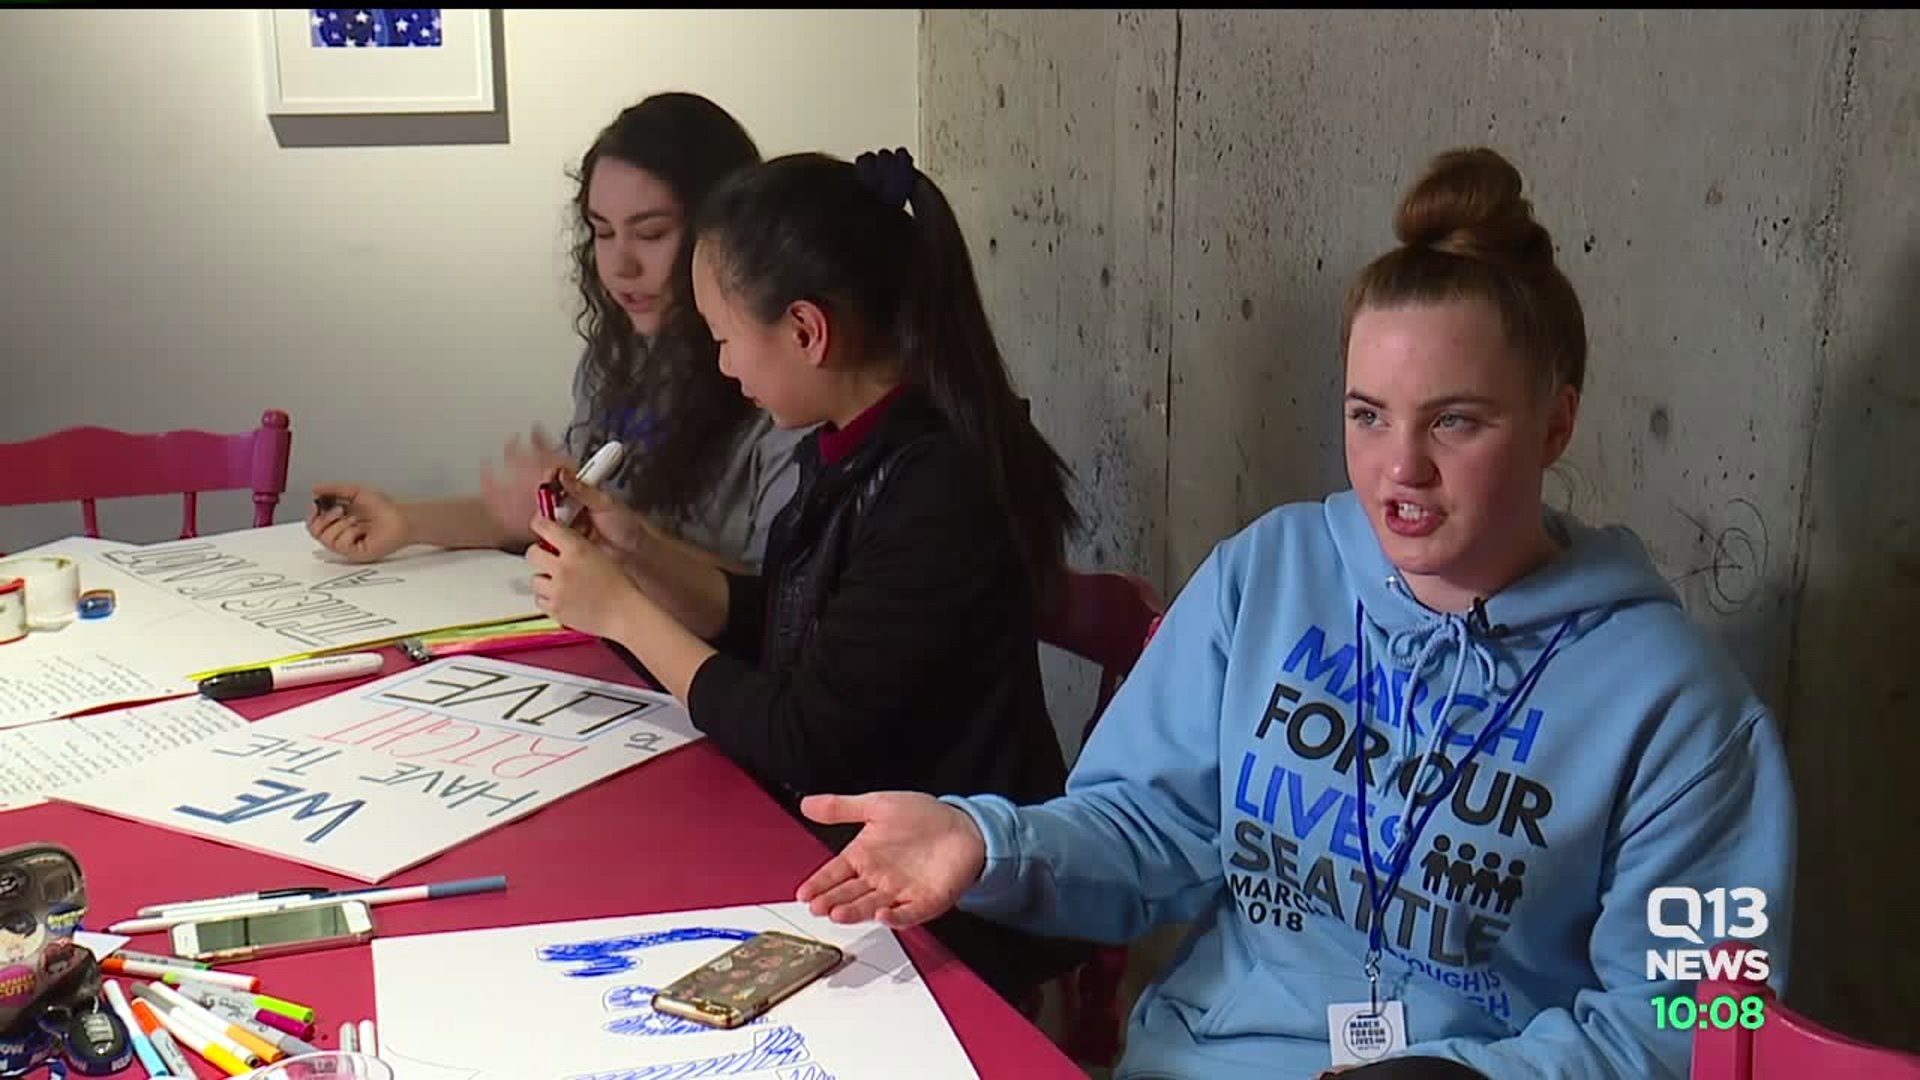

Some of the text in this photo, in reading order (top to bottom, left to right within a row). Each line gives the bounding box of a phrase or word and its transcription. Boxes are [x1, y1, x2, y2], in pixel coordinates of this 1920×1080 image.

[383, 665, 663, 752] TO LIVE
[1282, 625, 1544, 763] MARCH
[211, 733, 343, 775] THE
[308, 706, 589, 779] RIGHT
[1255, 683, 1553, 848] FOR OUR
[173, 779, 367, 843] WE
[358, 761, 540, 817] HAVE
[1235, 751, 1411, 876] LIVES
[1229, 819, 1512, 967] SEATTLE
[1230, 873, 1325, 916] MARC
[1237, 900, 1303, 932] 018
